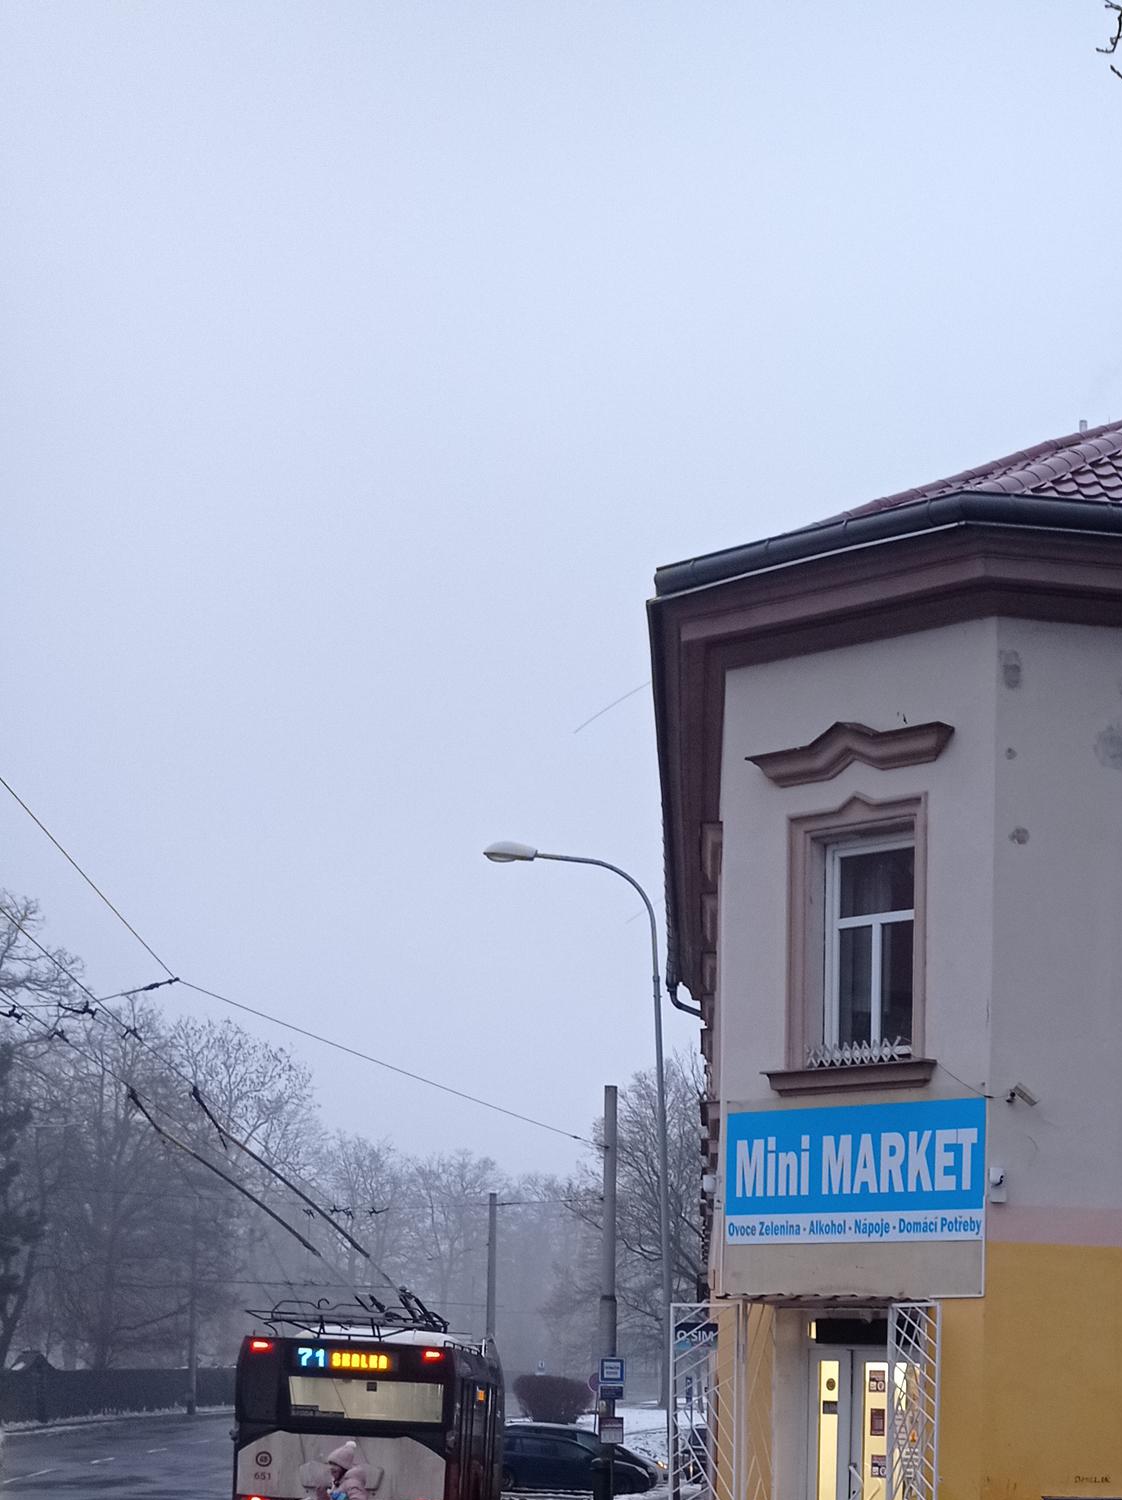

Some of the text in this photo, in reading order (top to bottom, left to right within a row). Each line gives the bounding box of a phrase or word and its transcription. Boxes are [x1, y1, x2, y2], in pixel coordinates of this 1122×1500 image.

[735, 1127, 978, 1198] Mini MARKET
[728, 1215, 982, 1238] Ovoce Zelenina Alkohol Nápoje Domácí Potřeby
[298, 1347, 325, 1368] 71
